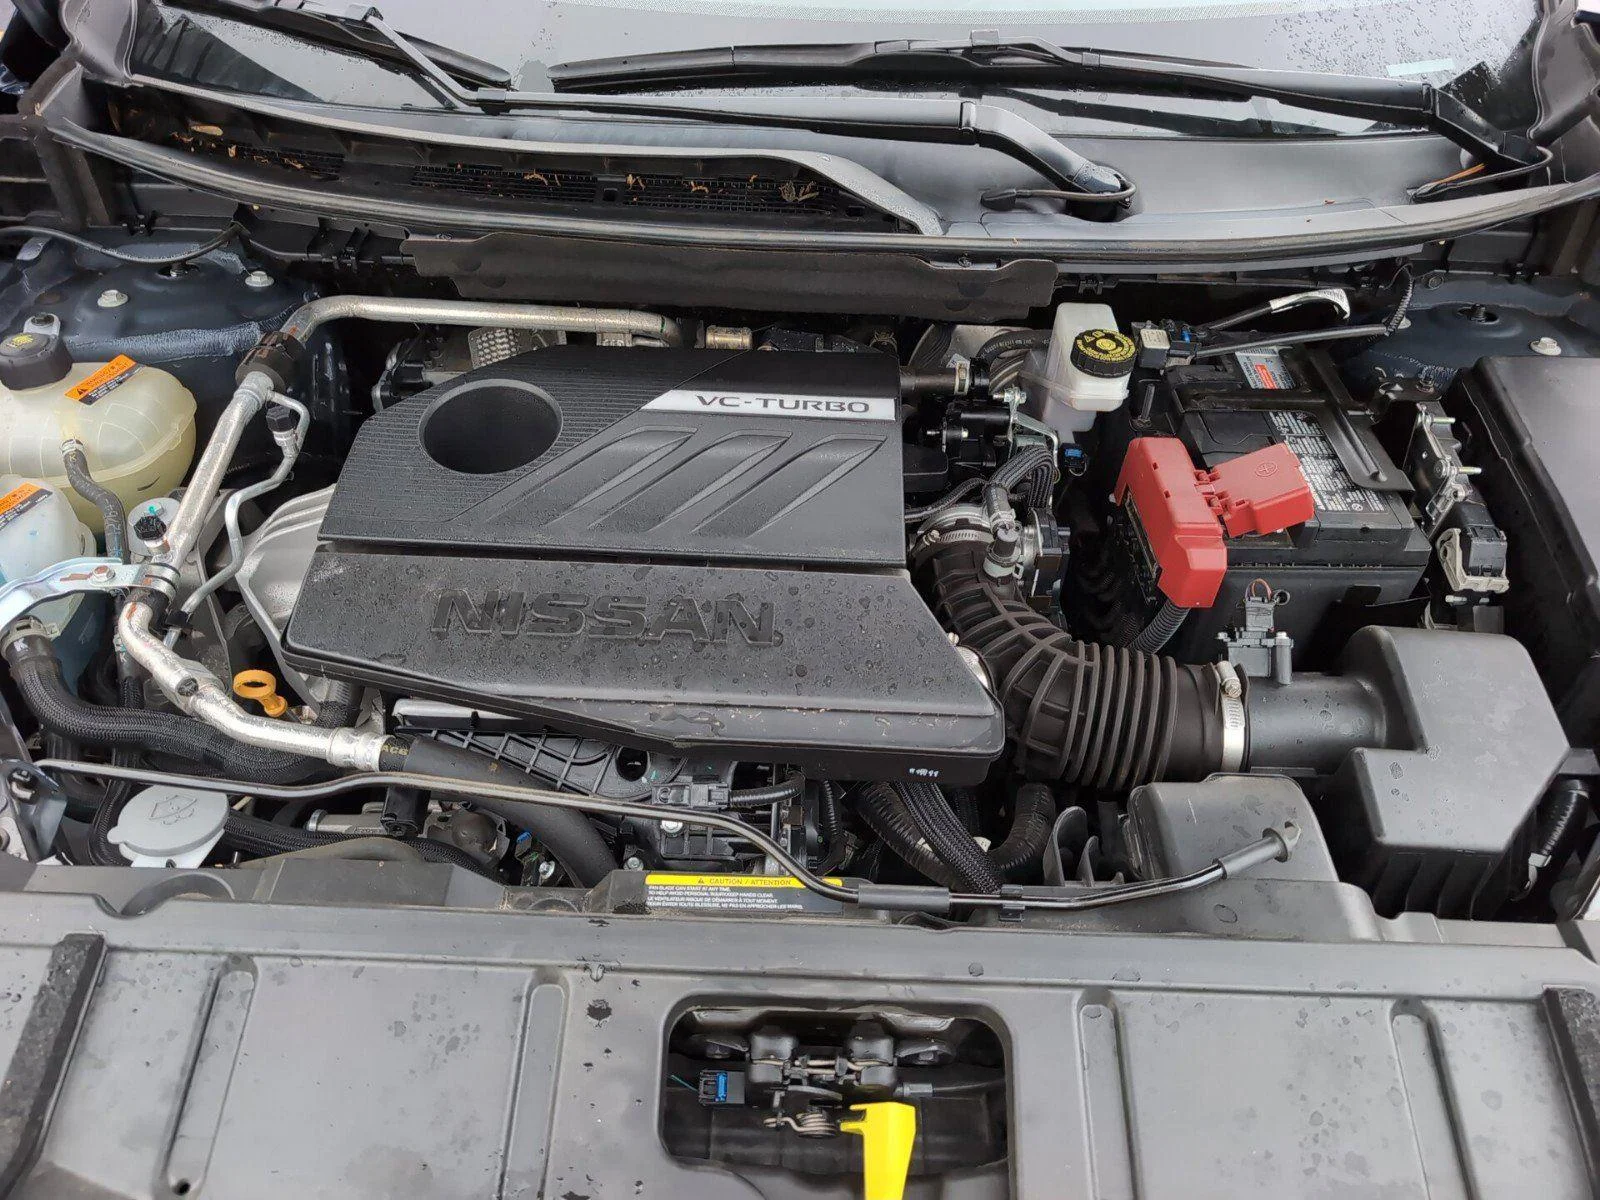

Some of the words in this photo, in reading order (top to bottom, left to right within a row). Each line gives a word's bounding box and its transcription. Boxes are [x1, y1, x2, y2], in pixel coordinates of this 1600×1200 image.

[696, 395, 870, 413] VC-TURBO
[431, 589, 777, 646] NISSAN
[709, 877, 742, 885] CAUTION
